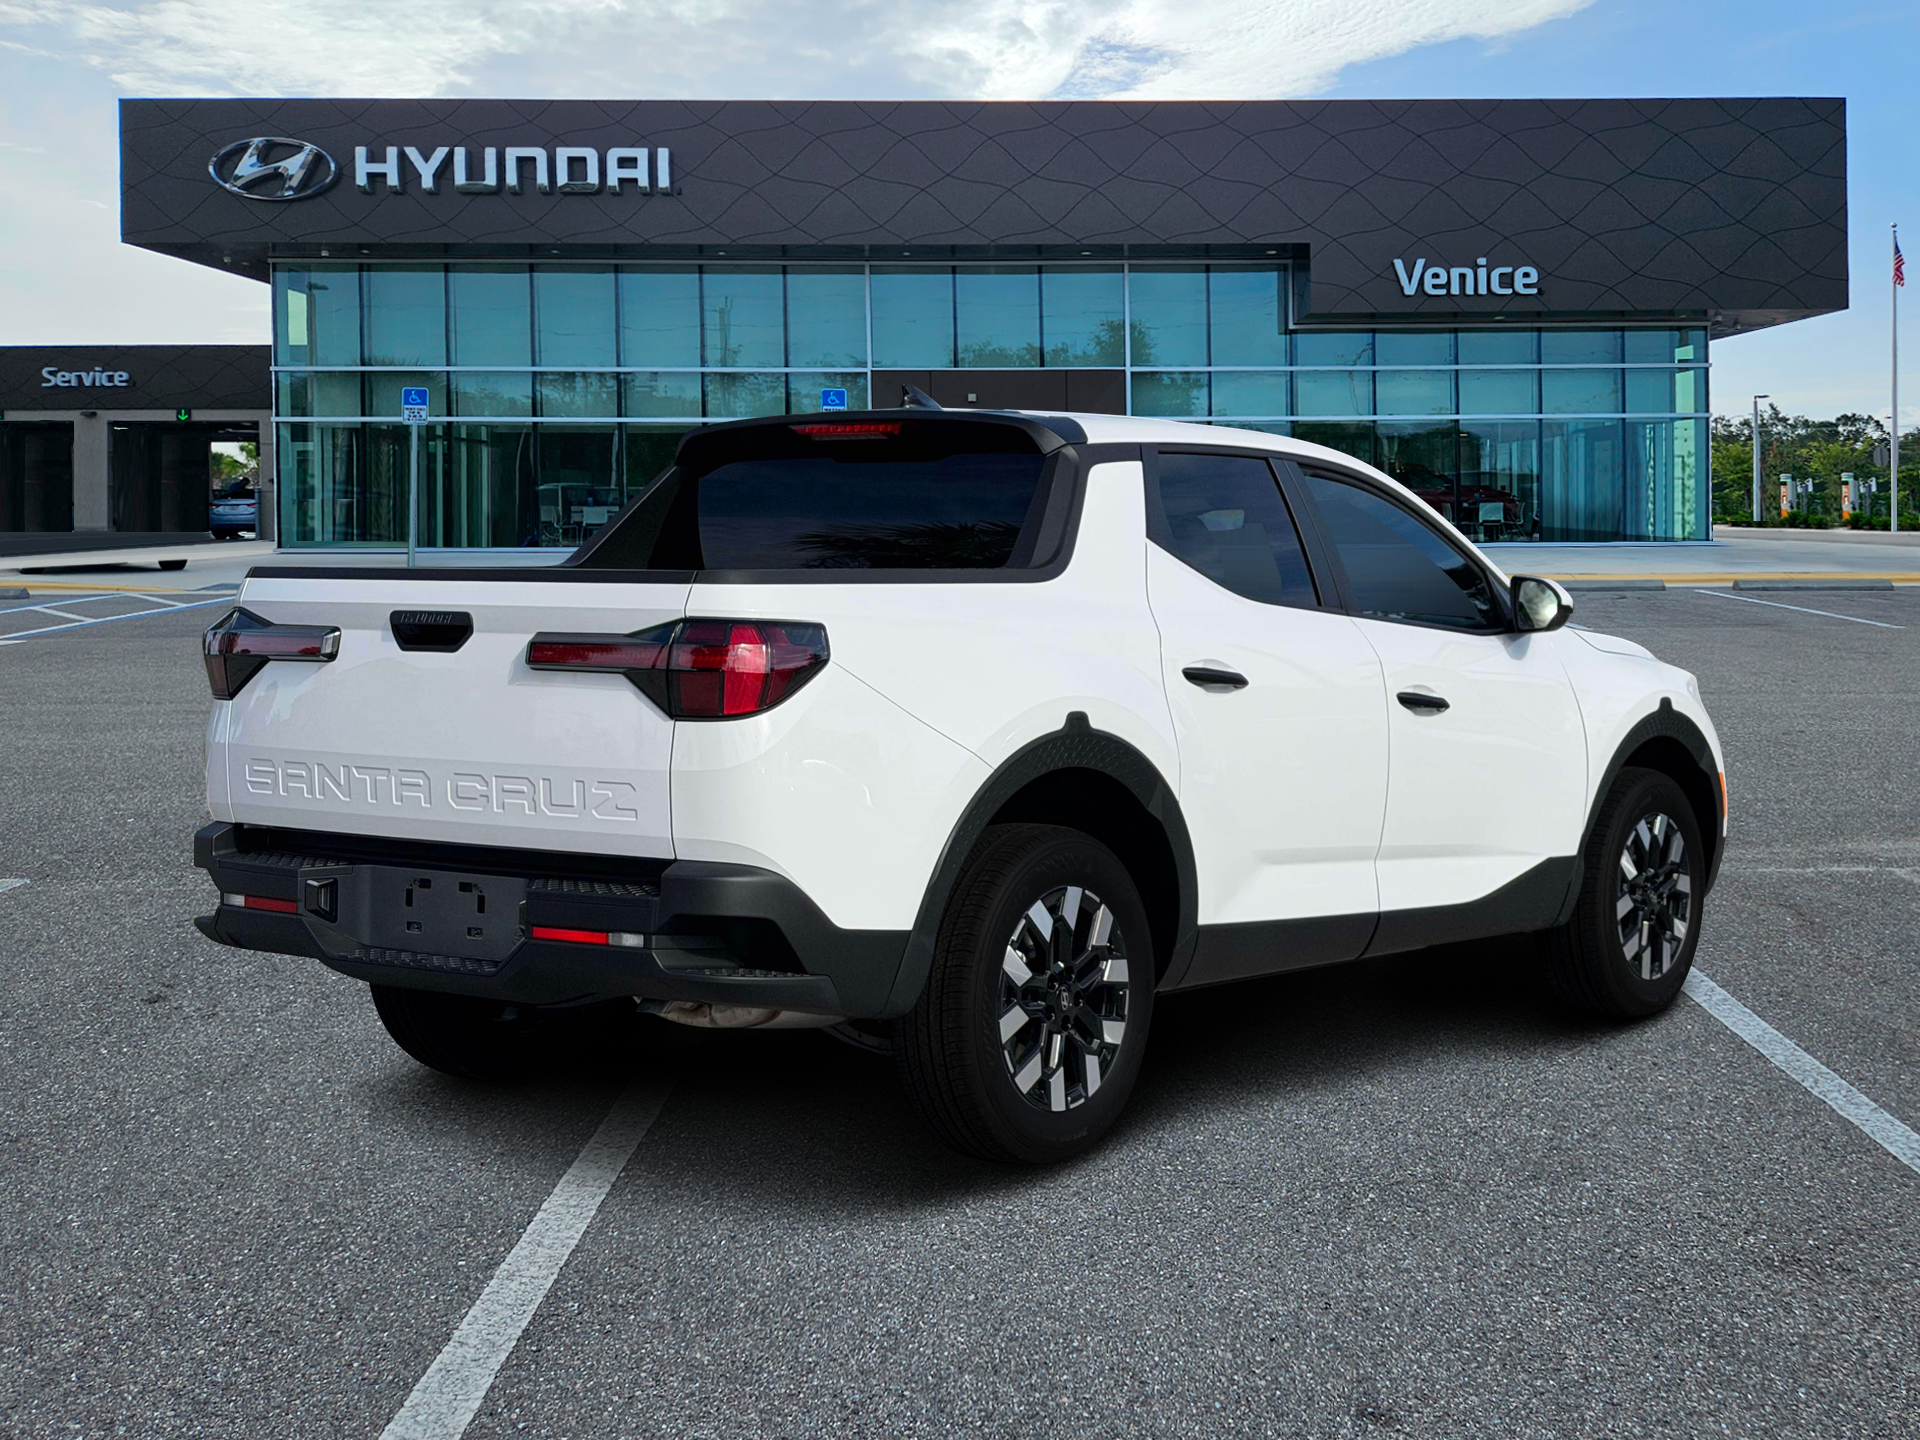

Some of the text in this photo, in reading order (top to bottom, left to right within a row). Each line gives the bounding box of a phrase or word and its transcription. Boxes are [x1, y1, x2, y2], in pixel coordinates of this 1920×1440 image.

[354, 146, 671, 195] HYUNDAI
[1393, 257, 1539, 296] Venice
[41, 366, 130, 387] Service
[245, 757, 639, 821] SANTA CRUZ
